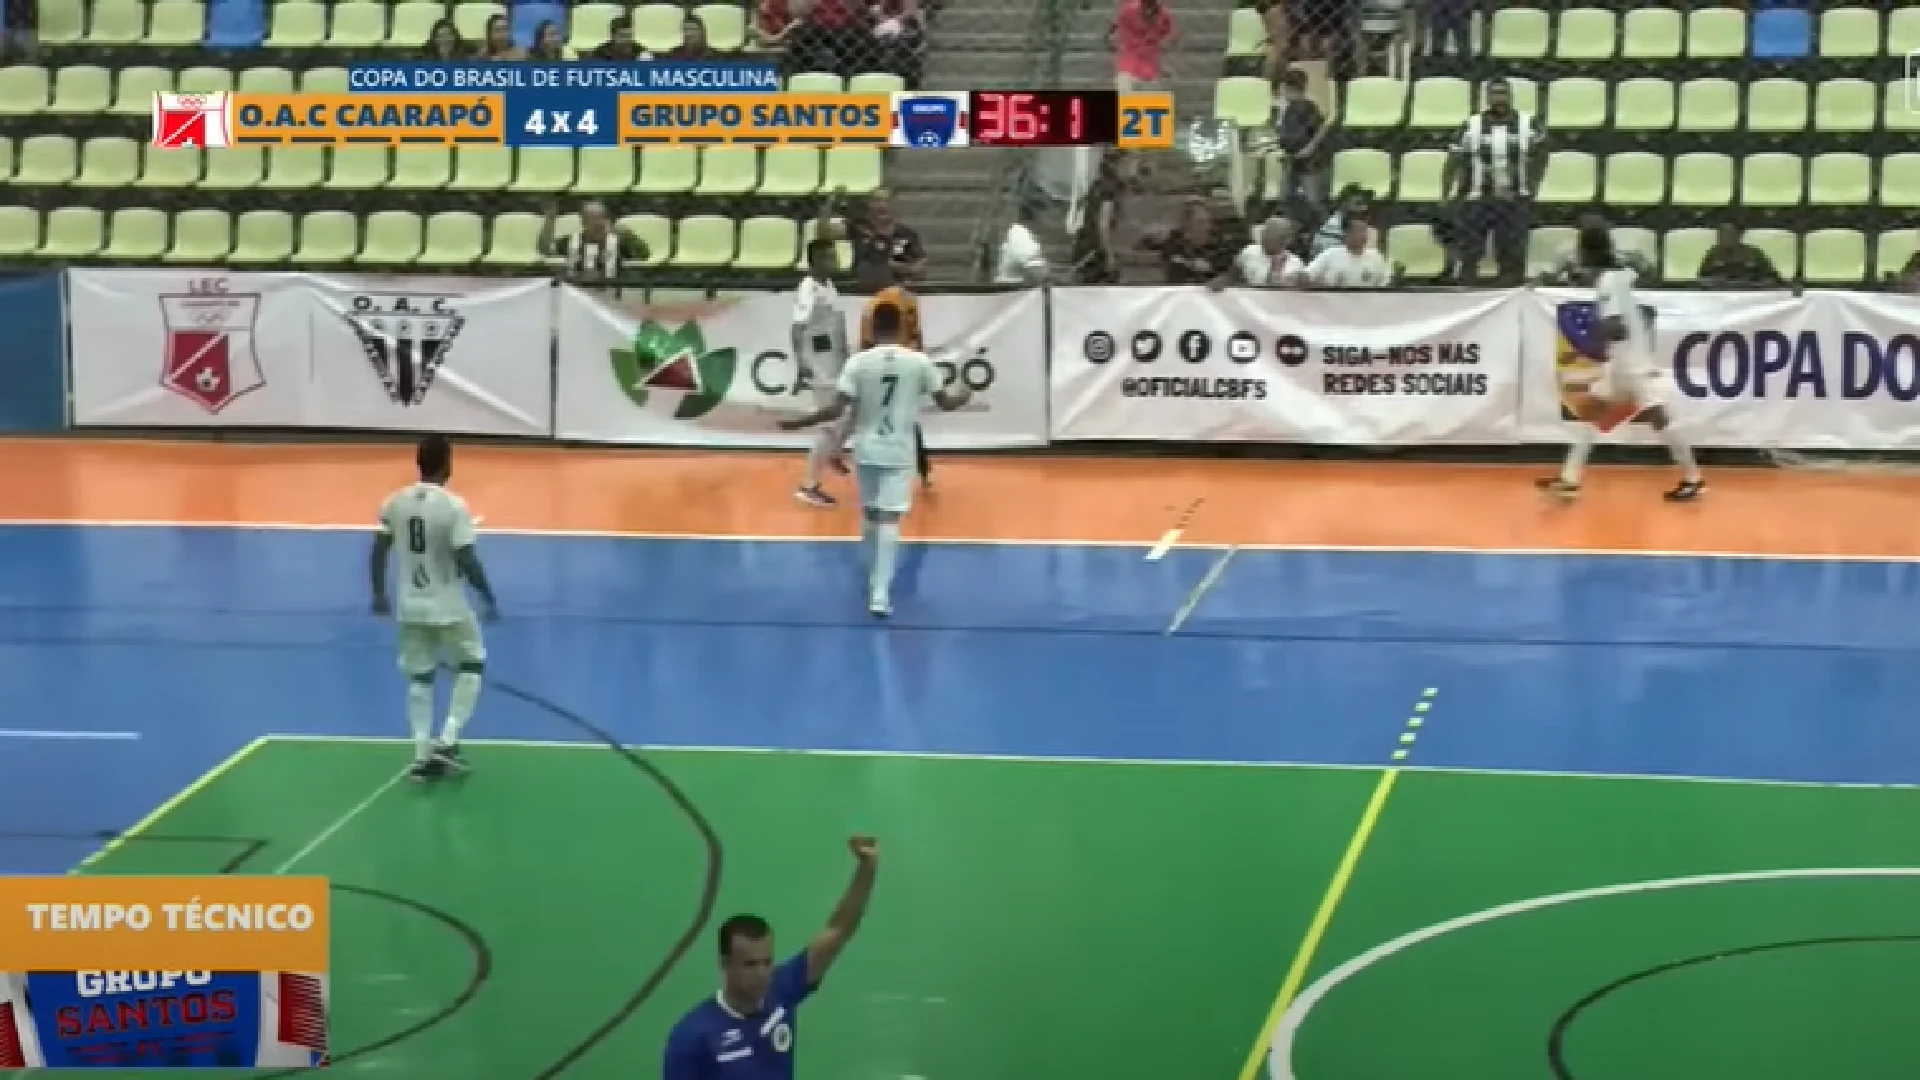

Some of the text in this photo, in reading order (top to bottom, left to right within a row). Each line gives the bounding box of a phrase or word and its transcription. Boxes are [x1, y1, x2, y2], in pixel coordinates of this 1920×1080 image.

[188, 278, 230, 294] LEC
[1440, 343, 1481, 365] NAS
[1674, 330, 1920, 401] COPA DO
[881, 375, 900, 407] 7
[1323, 373, 1488, 396] REDES SOCIAIS
